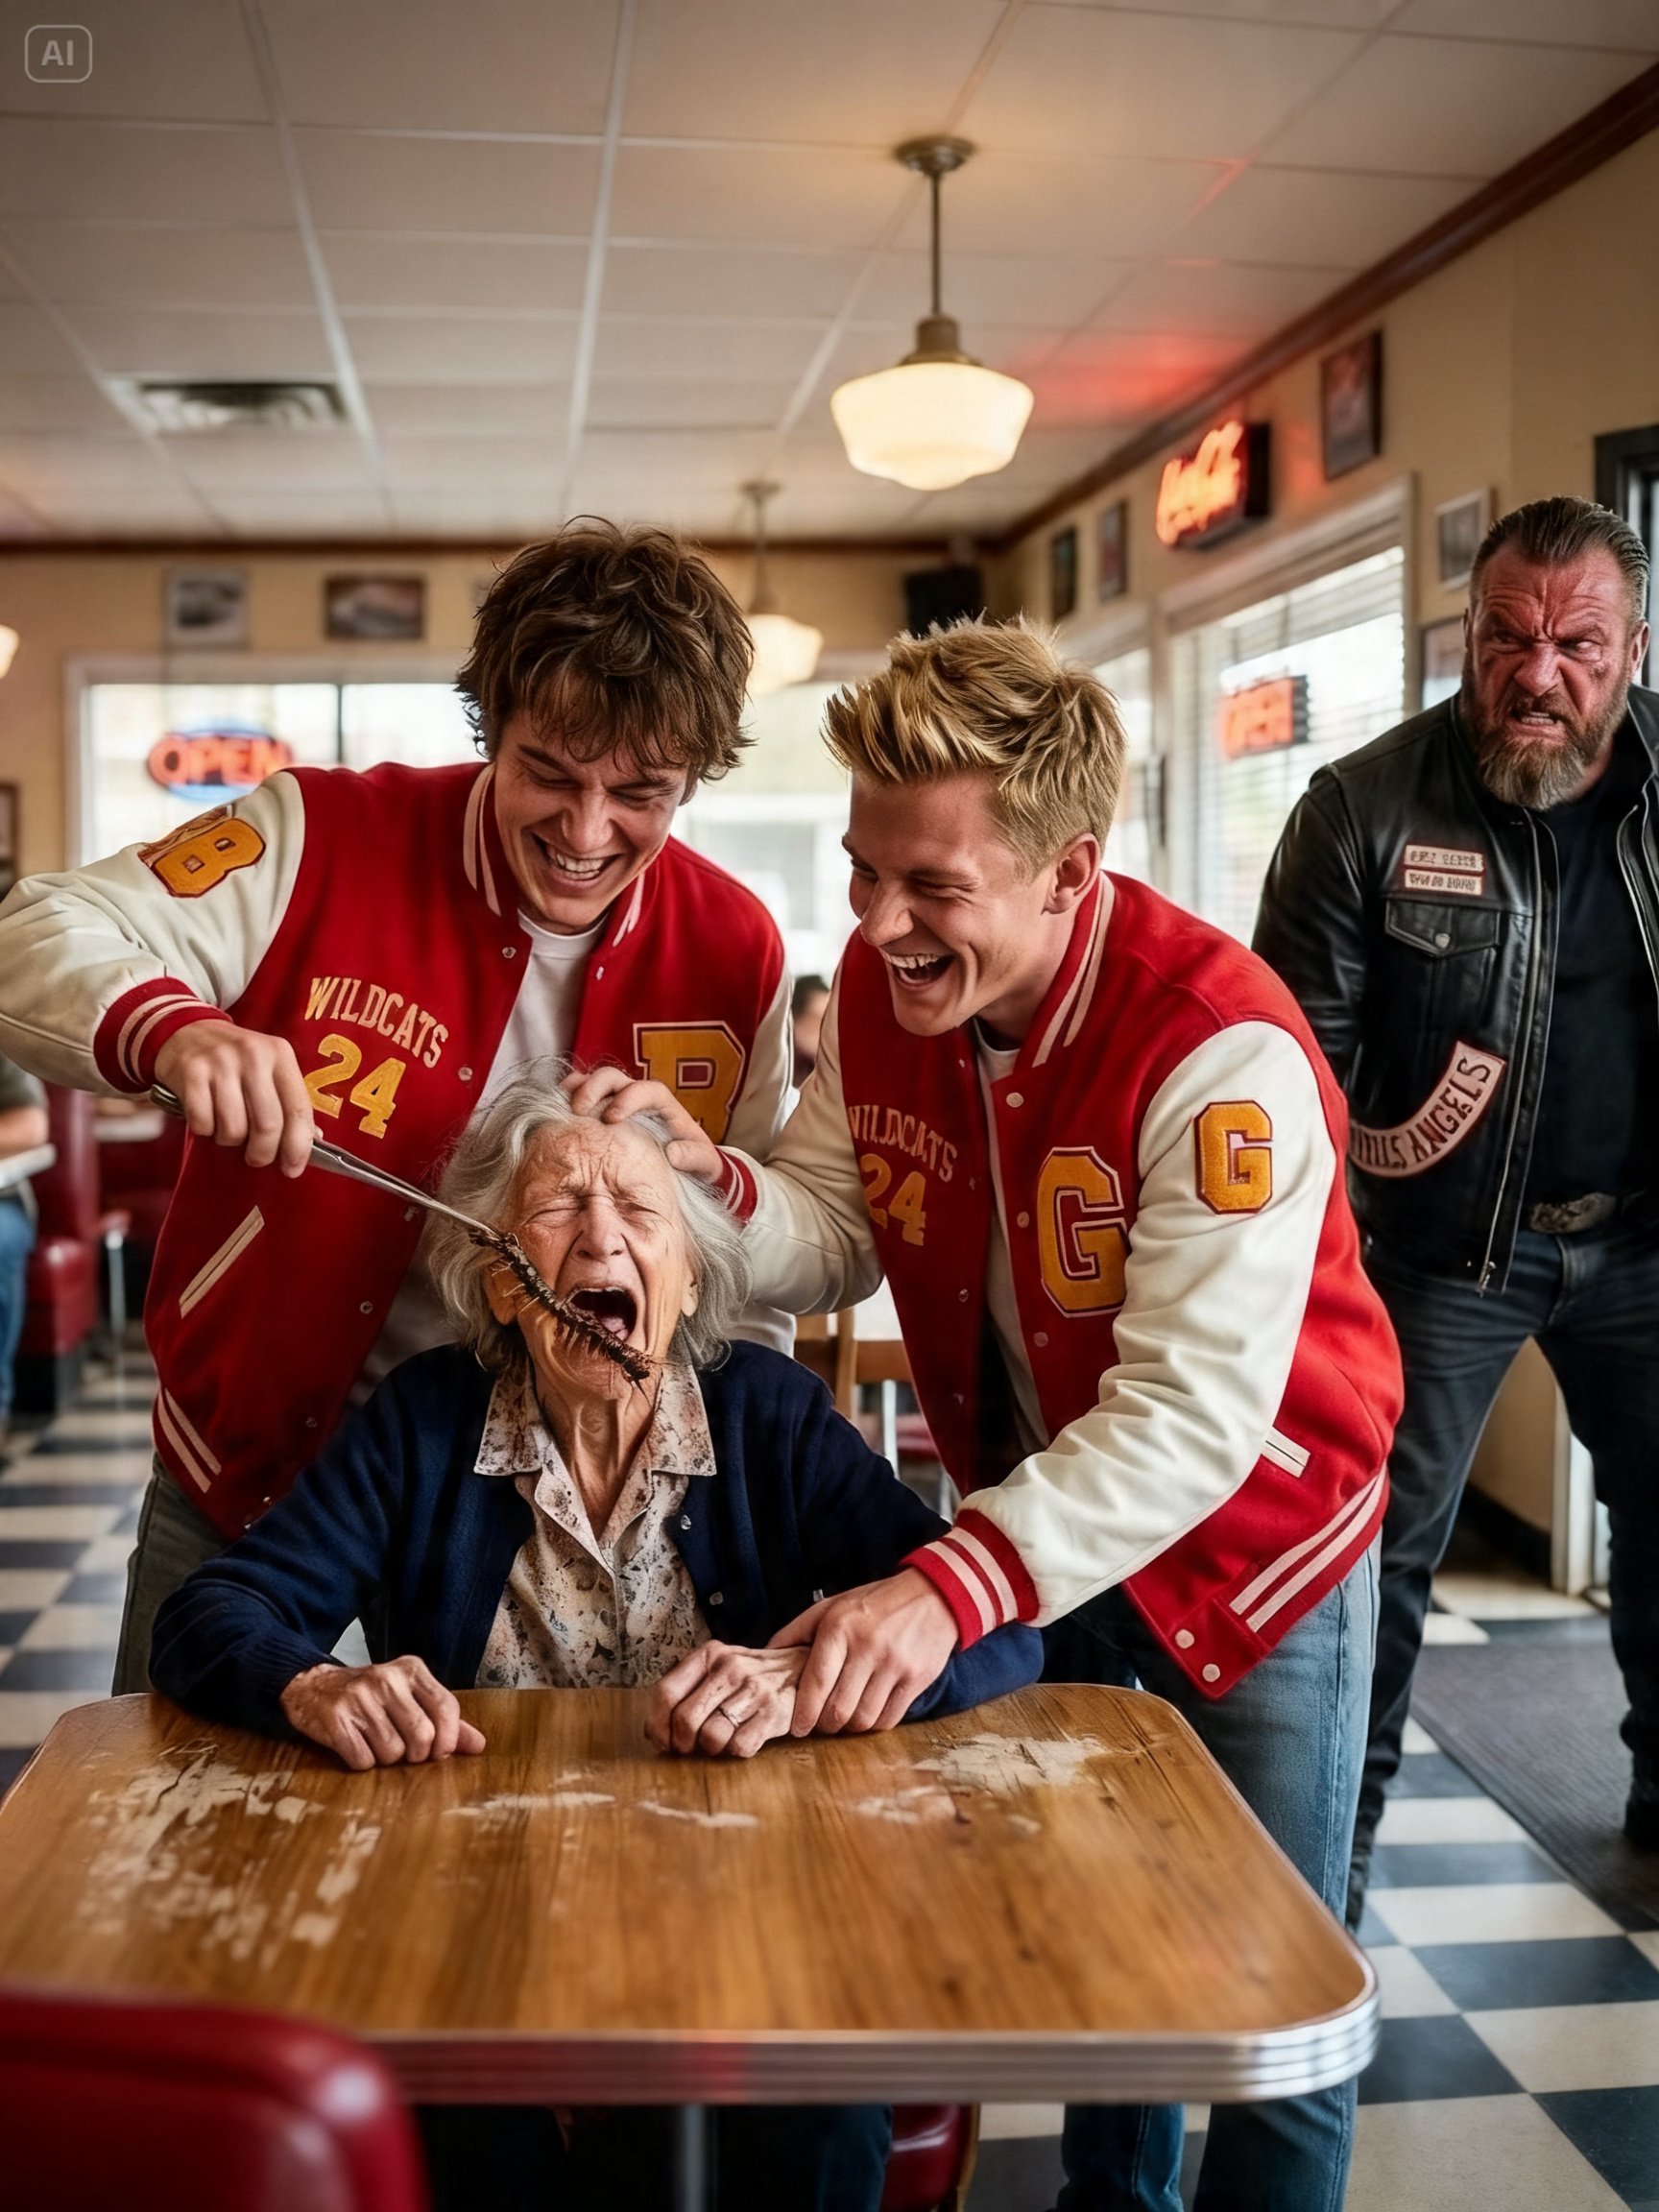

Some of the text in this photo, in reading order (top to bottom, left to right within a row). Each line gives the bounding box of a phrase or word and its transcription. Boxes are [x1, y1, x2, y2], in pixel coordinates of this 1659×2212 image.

[147, 733, 293, 786] OPEN
[303, 975, 449, 1069] WILDCATS
[303, 1033, 407, 1140] 24
[1406, 1056, 1491, 1164] ANGELS
[859, 1153, 926, 1246] 24
[1192, 1099, 1274, 1214] G
[1037, 1146, 1128, 1318] G
